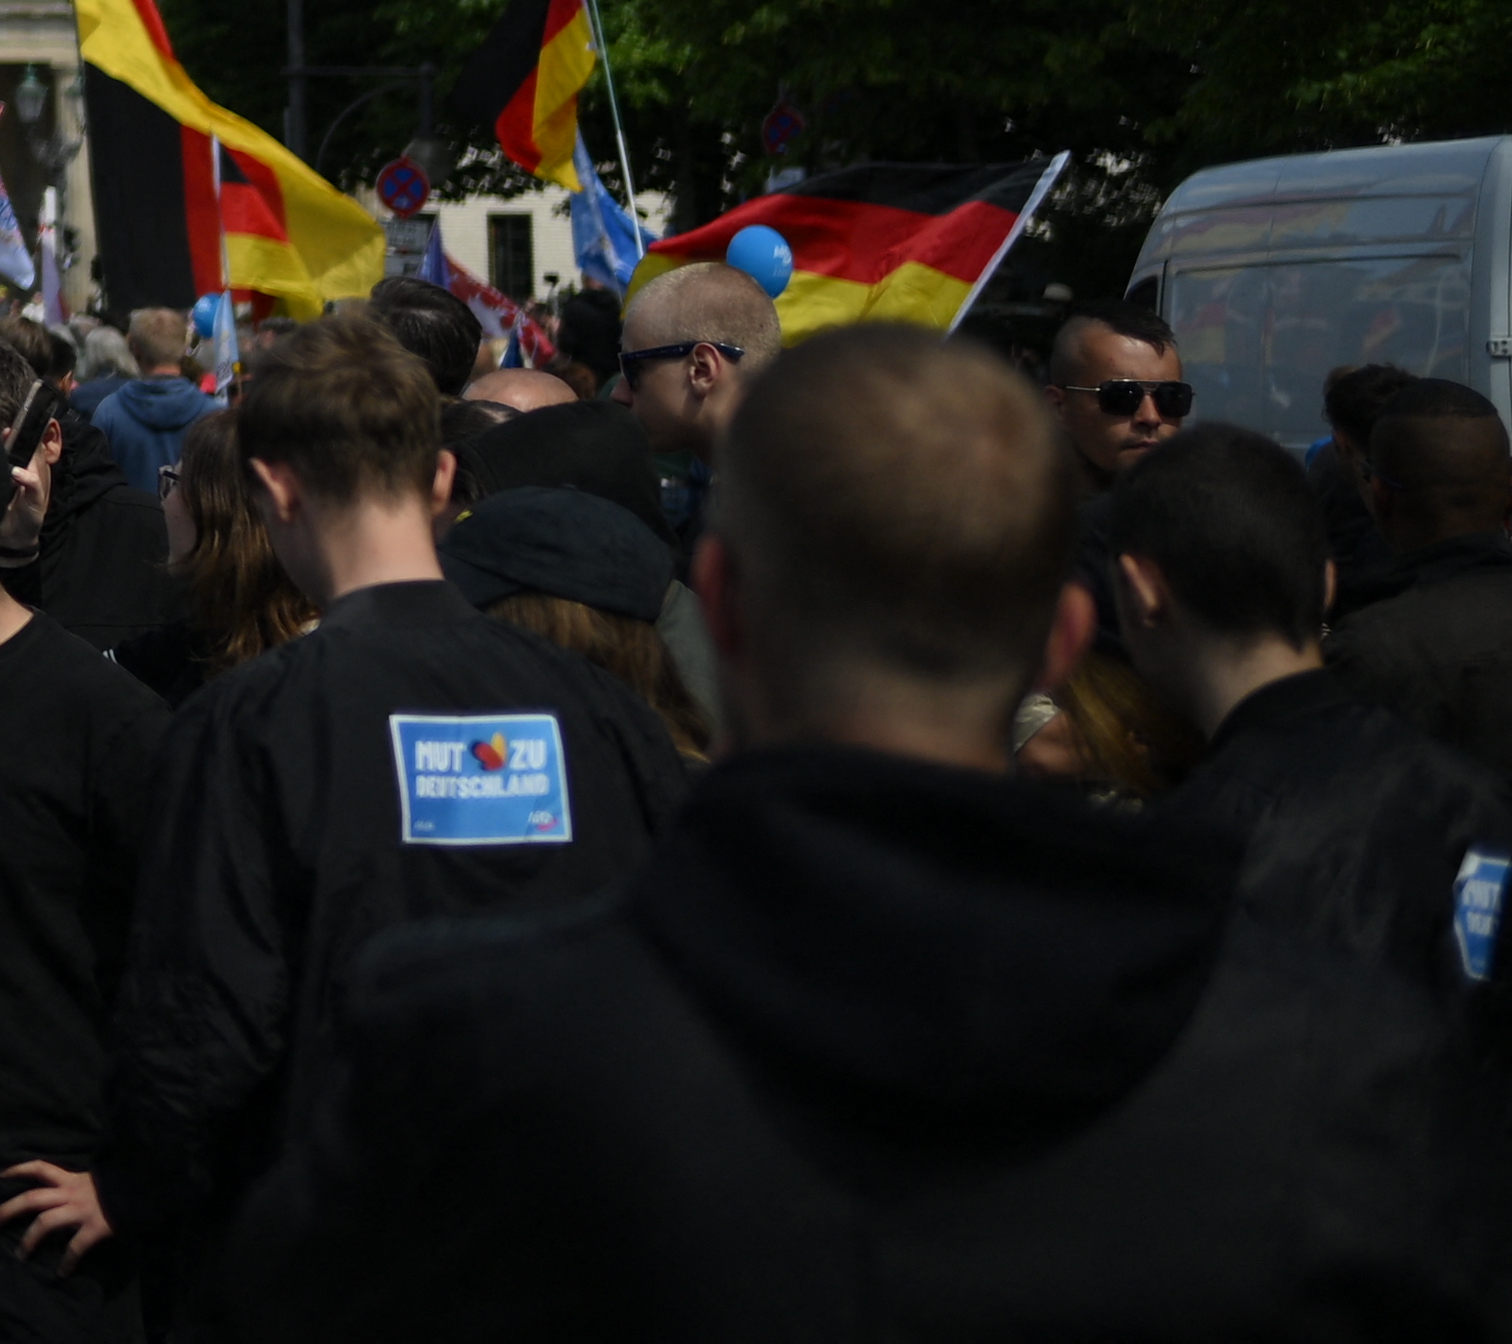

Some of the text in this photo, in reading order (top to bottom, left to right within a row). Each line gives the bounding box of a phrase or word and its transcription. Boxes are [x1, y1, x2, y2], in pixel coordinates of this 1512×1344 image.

[415, 739, 547, 772] MUT ZU
[416, 774, 550, 799] DEUTSCHLAND
